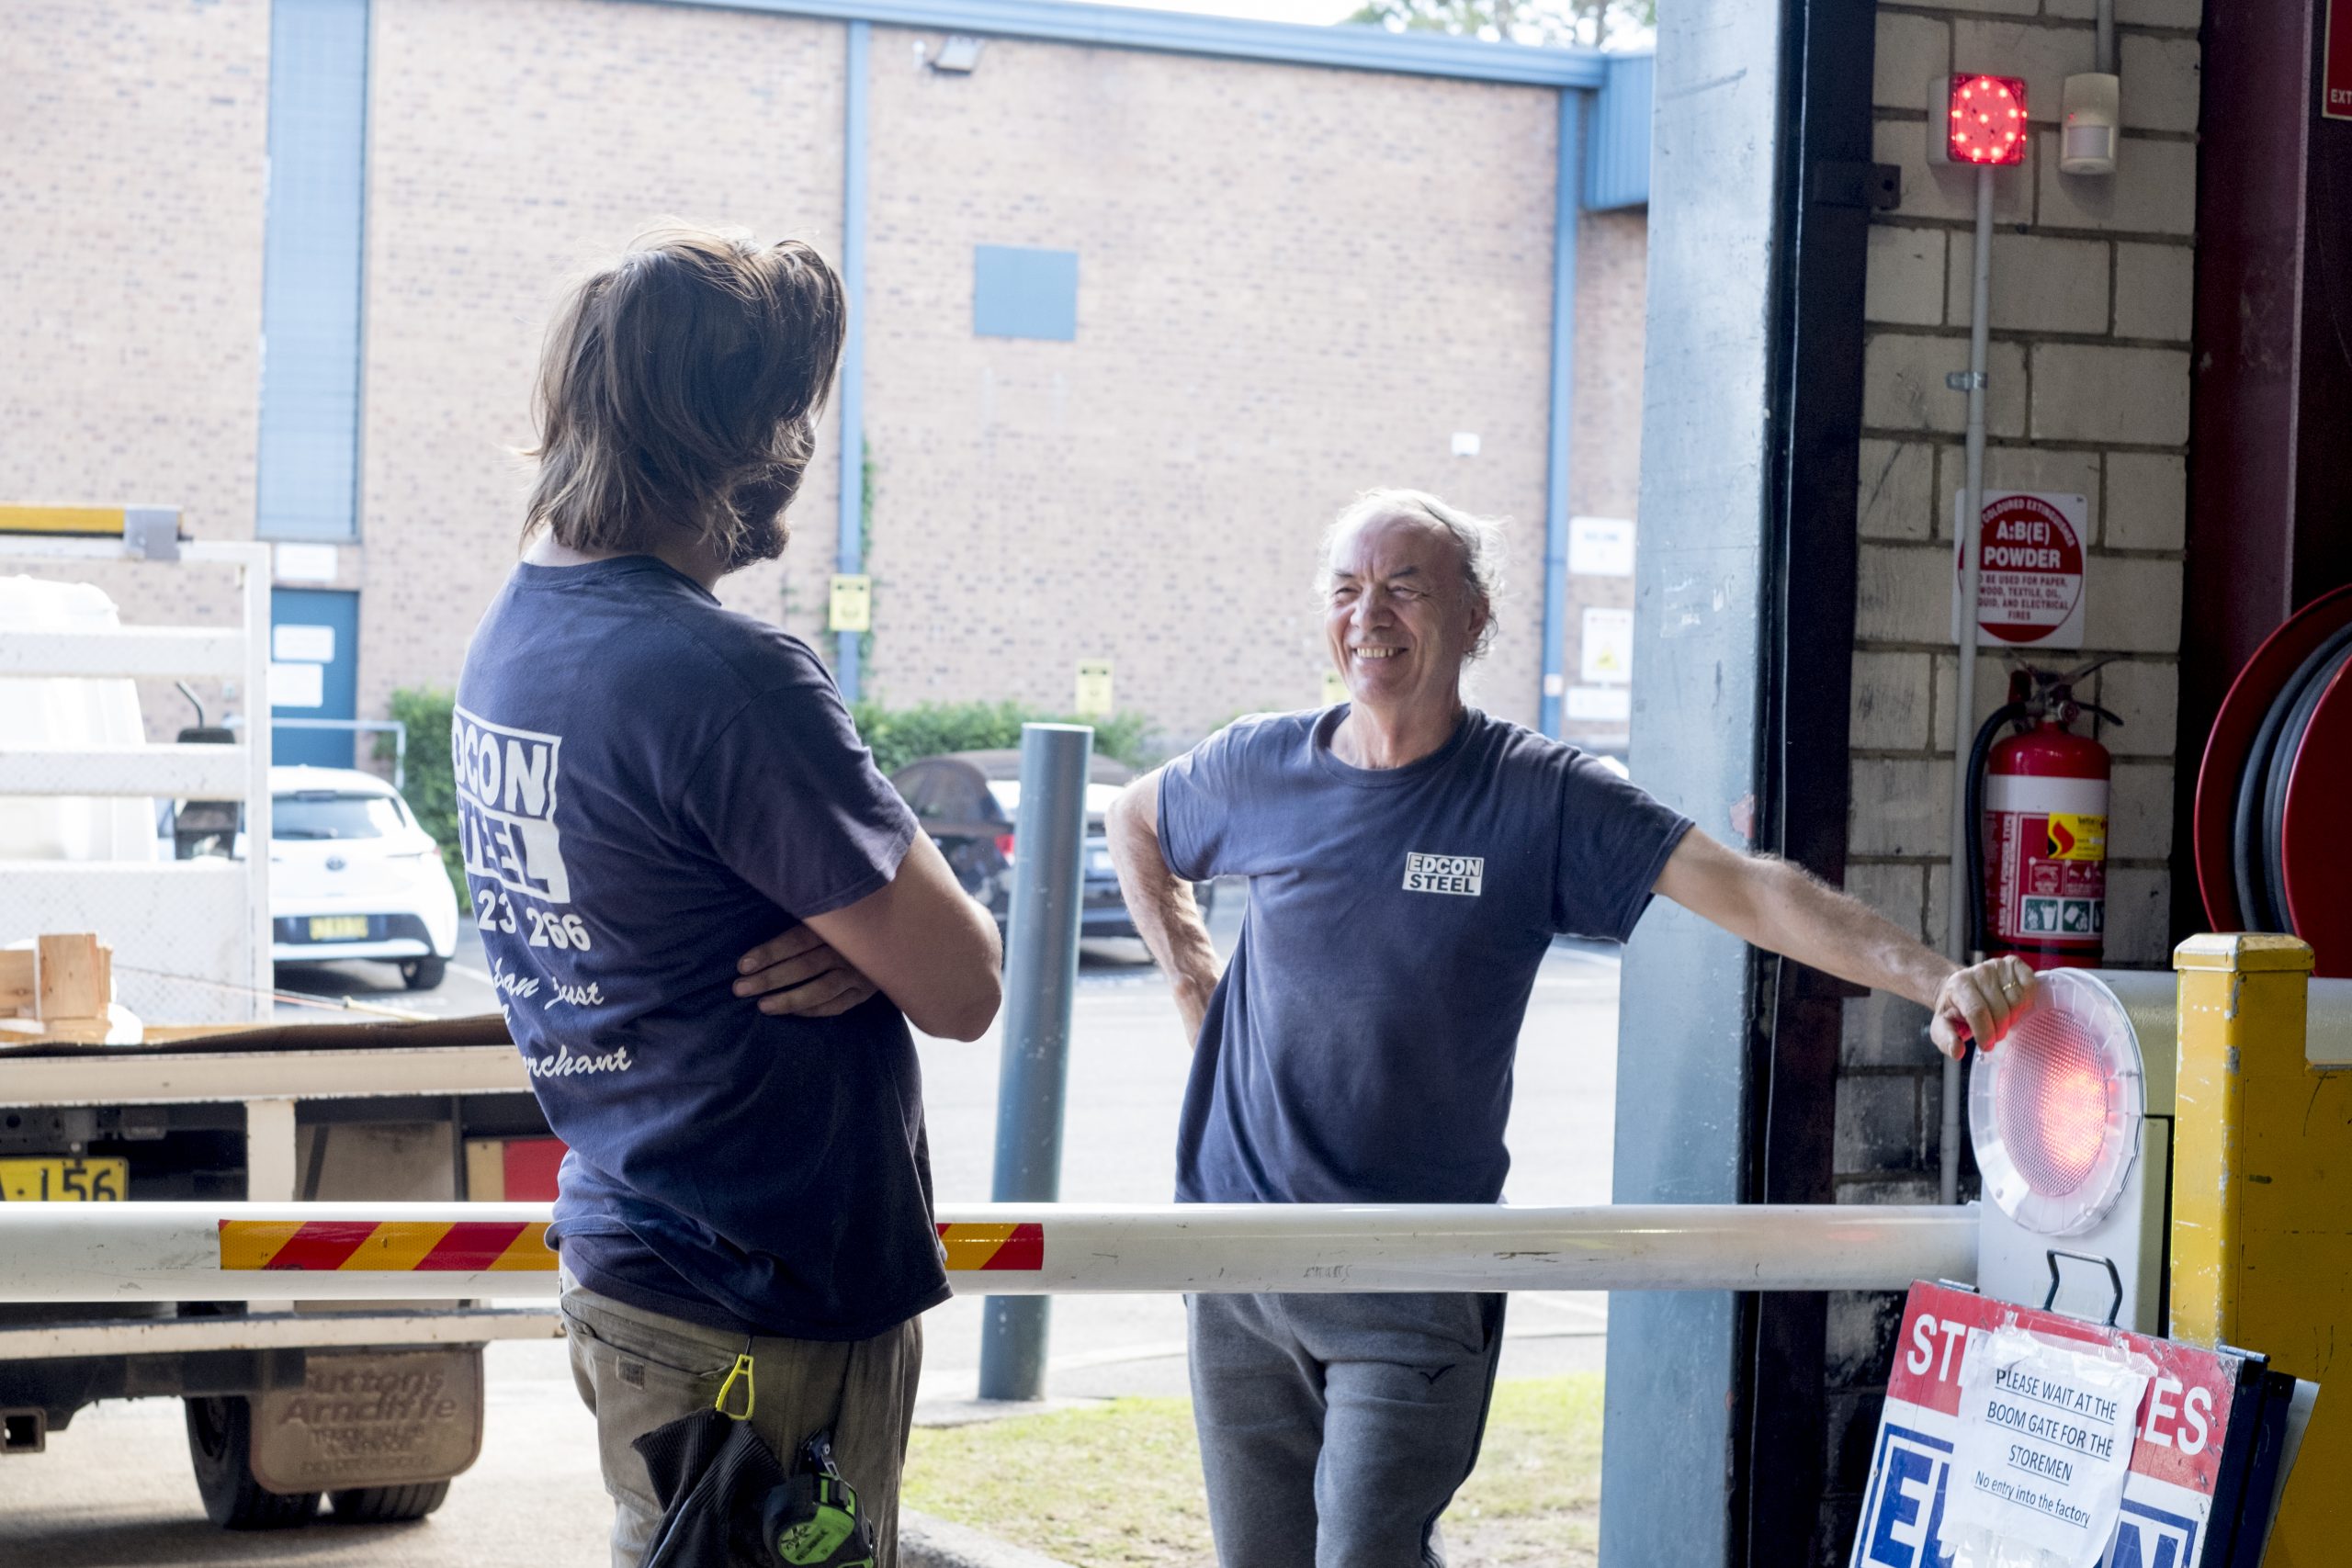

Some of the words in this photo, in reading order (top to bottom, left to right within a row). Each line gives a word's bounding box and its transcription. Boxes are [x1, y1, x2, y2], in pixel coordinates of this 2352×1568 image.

[1982, 498, 2025, 524] COLOURED
[2026, 499, 2075, 547] EXTINGUISHER
[1996, 520, 2050, 546] A:B(E)
[1984, 547, 2061, 569] POWDER
[1985, 574, 1996, 584] BE
[1998, 574, 2020, 585] USED
[2022, 575, 2037, 586] FOR
[2002, 599, 2019, 608] AND
[2021, 599, 2069, 610] ELECTRICAL
[2007, 611, 2031, 621] FIRES
[1408, 853, 1481, 877] EDCON
[1408, 874, 1476, 894] STEEL
[526, 907, 592, 952] 266
[1996, 1368, 2041, 1396] PLEASE
[2041, 1381, 2075, 1406] WAIT
[2074, 1392, 2093, 1413] AT
[2095, 1396, 2118, 1421] THE
[1986, 1401, 2031, 1429] BOOM
[2028, 1414, 2060, 1439] GATE
[2060, 1424, 2087, 1449] FOR
[2090, 1433, 2114, 1458] THE
[2008, 1444, 2074, 1482] STOREMEN
[1975, 1470, 1990, 1488] No
[1991, 1479, 2015, 1500] entry
[2016, 1484, 2038, 1506] into
[2038, 1494, 2054, 1512] the
[2054, 1498, 2091, 1526] factory
